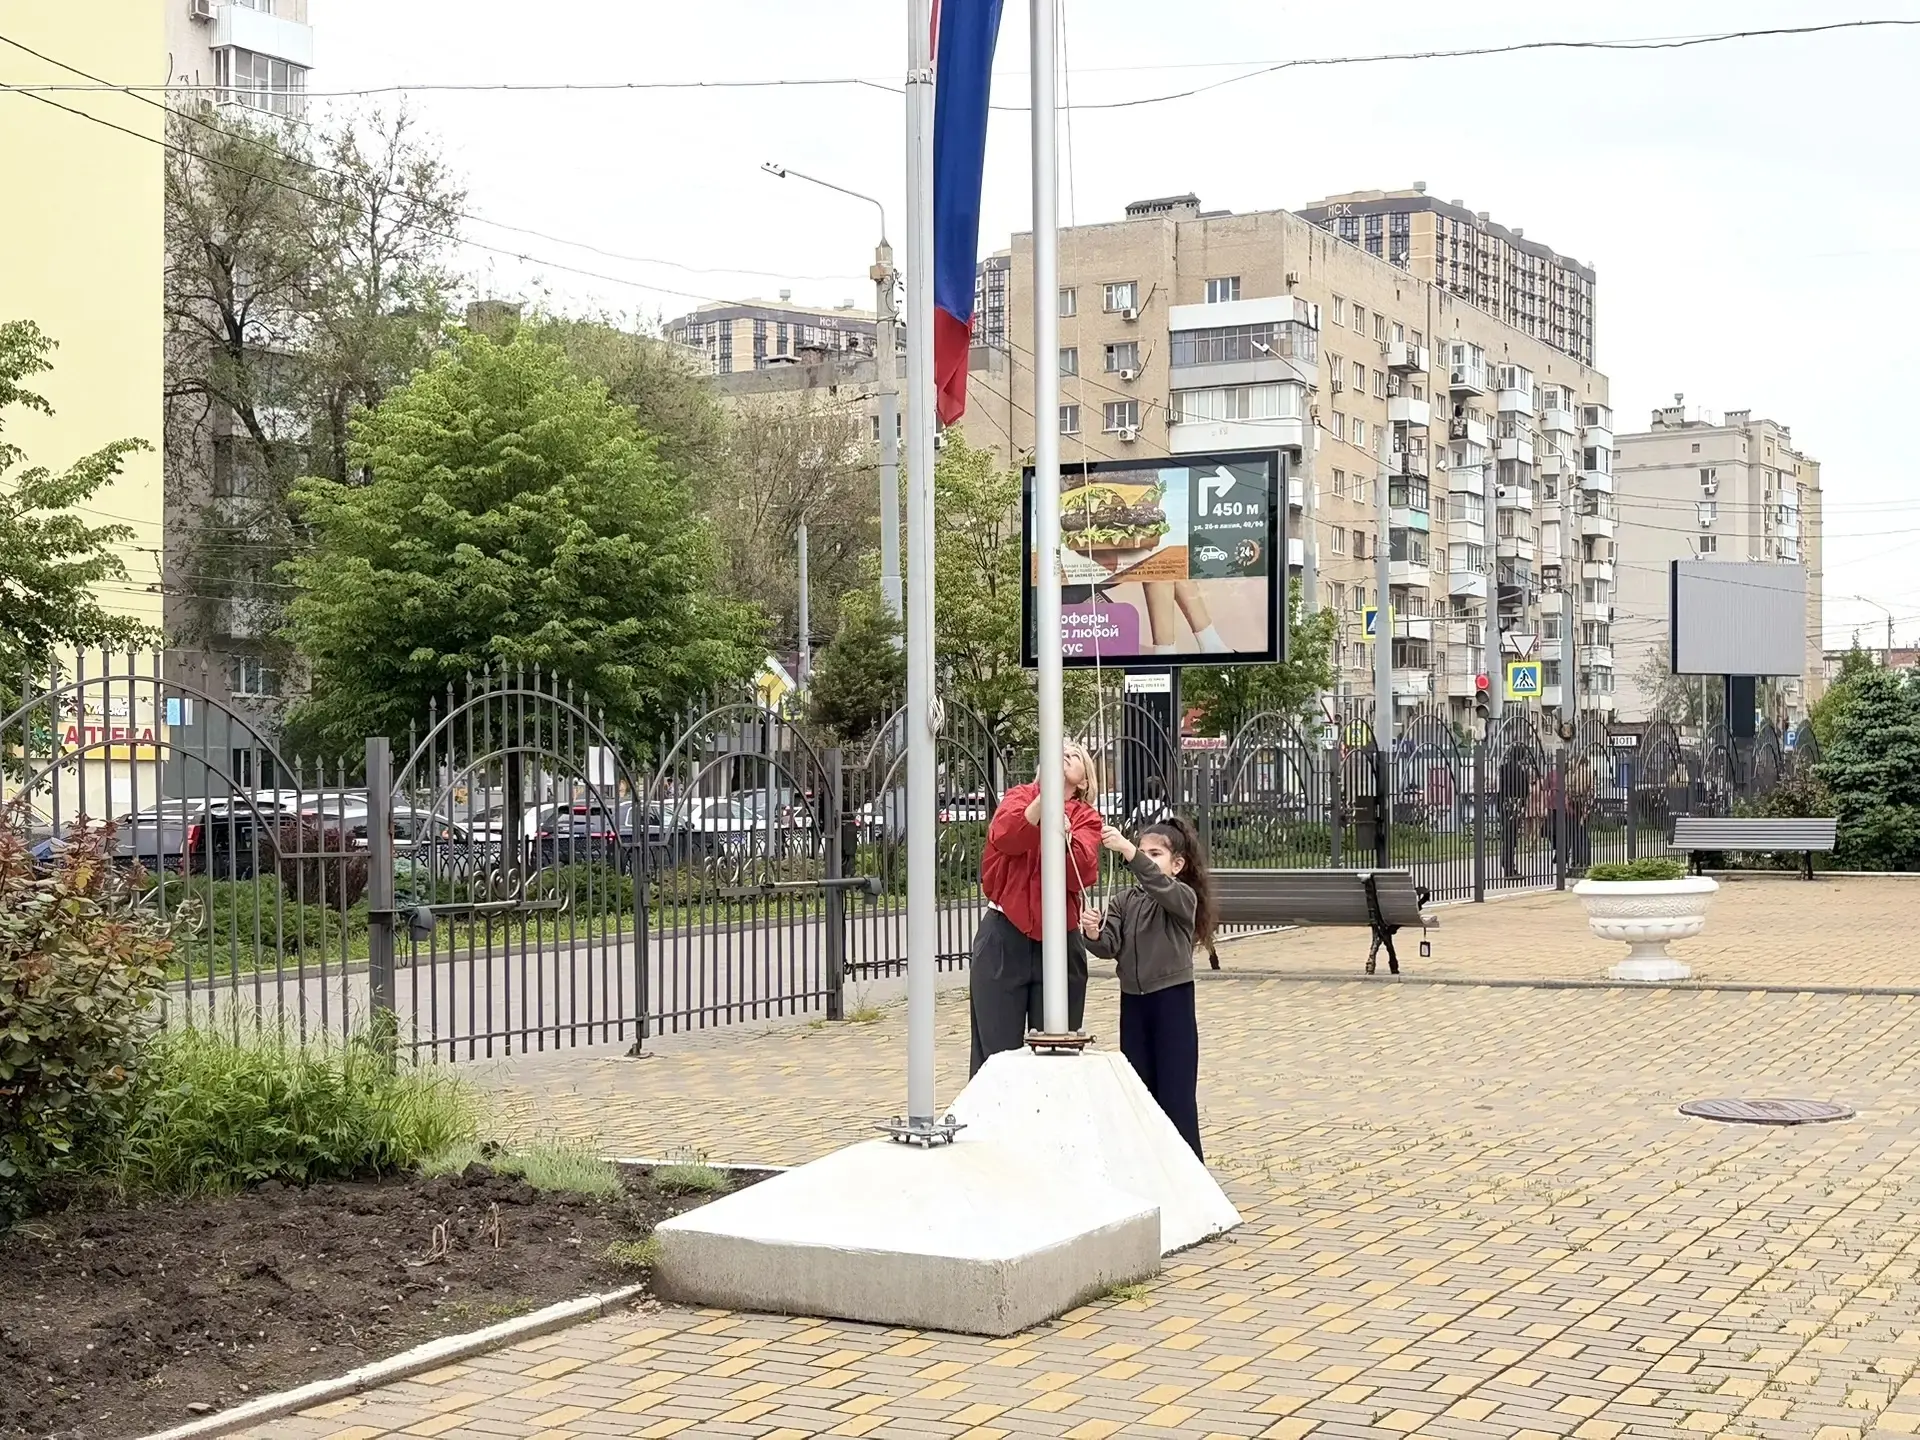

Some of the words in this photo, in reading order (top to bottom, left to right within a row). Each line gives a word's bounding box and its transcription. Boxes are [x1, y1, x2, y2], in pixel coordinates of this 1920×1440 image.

[1212, 502, 1243, 516] 450
[1061, 612, 1109, 626] оферы
[1061, 629, 1069, 638] а
[1071, 624, 1119, 638] любой
[1061, 643, 1084, 655] кус
[64, 725, 156, 747] АПТЕКА
